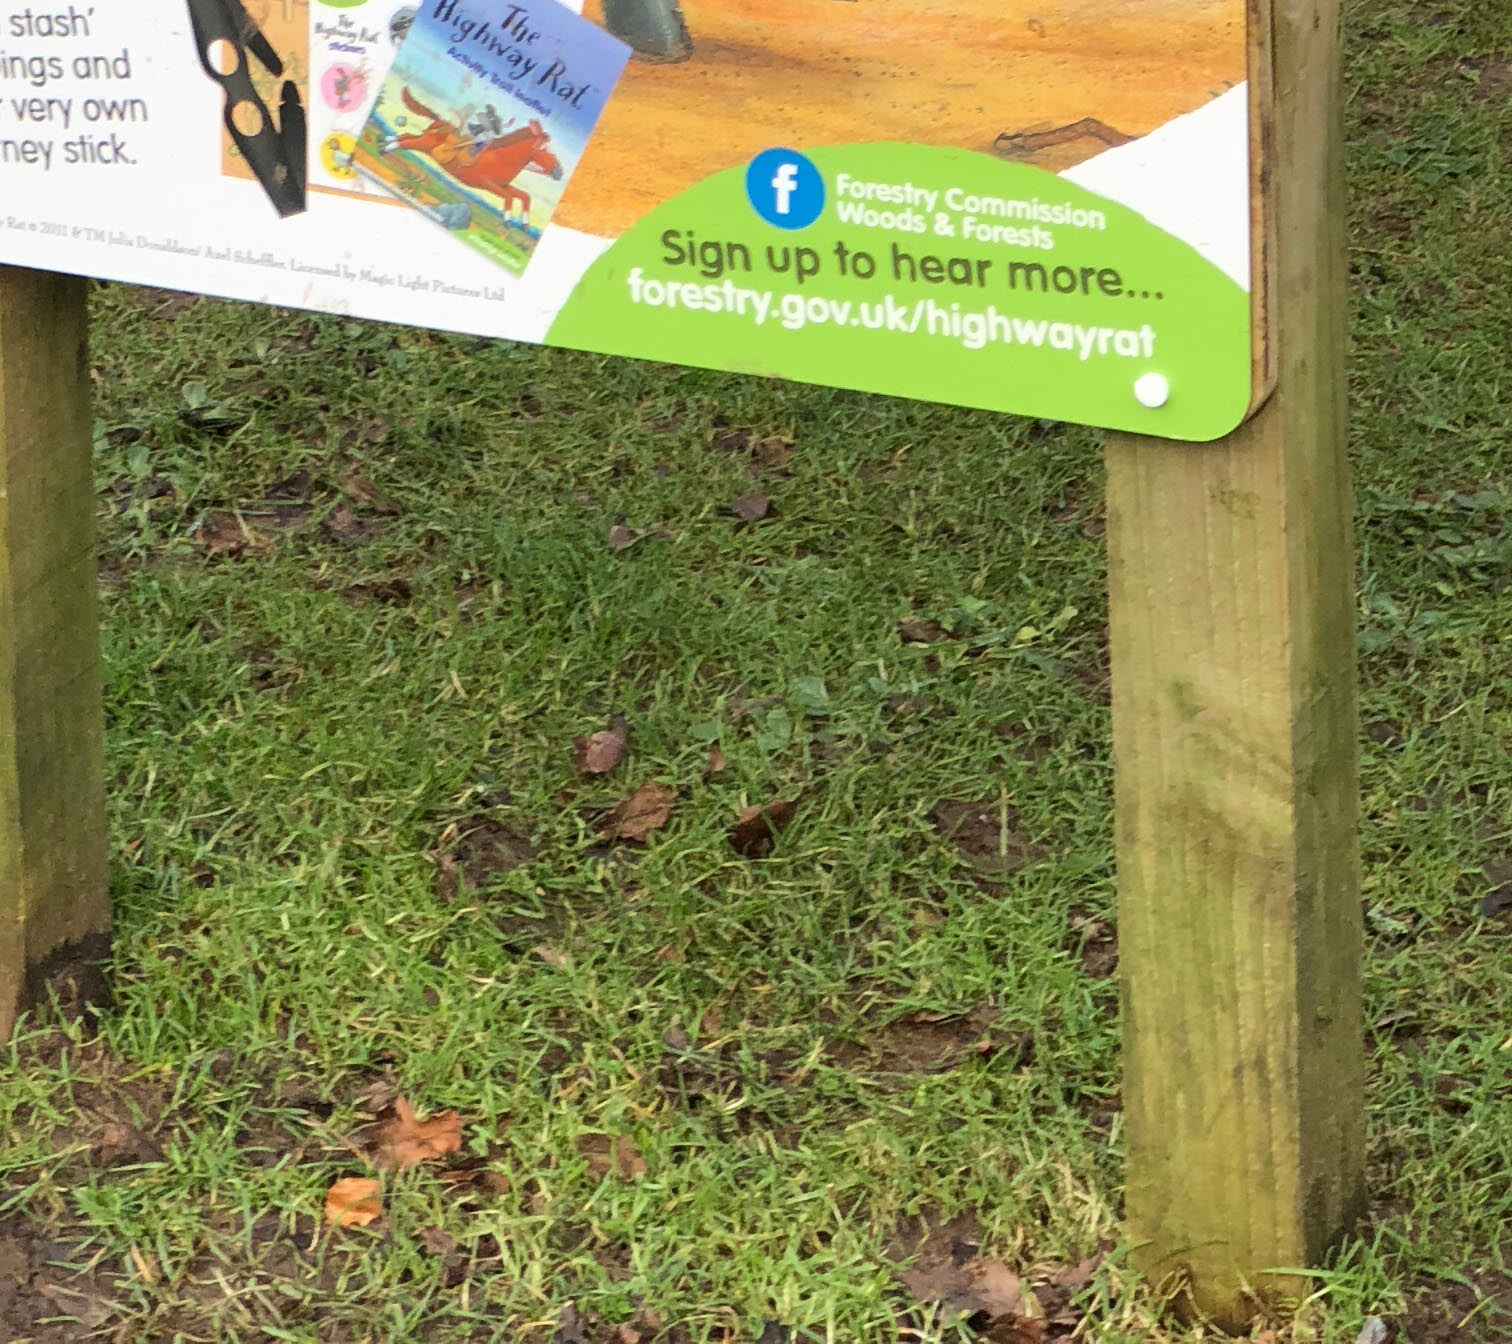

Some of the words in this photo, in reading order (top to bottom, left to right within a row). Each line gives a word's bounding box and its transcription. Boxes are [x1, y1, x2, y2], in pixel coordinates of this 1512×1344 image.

[500, 3, 541, 46] The
[73, 48, 132, 80] and
[537, 57, 591, 111] Rat
[12, 97, 73, 129] very
[83, 97, 149, 122] own
[64, 133, 138, 165] stick.
[835, 173, 939, 214] Forestry
[945, 185, 1108, 232] Commission
[835, 200, 928, 235] Woods
[933, 212, 955, 238] &
[961, 214, 1055, 251] Forests
[660, 228, 751, 280] Sign
[766, 243, 820, 285] up
[834, 245, 876, 281] to
[891, 241, 993, 290] hear
[1007, 260, 1166, 301] more...
[626, 267, 1157, 362] forestry.gov.uk/highwayrat
